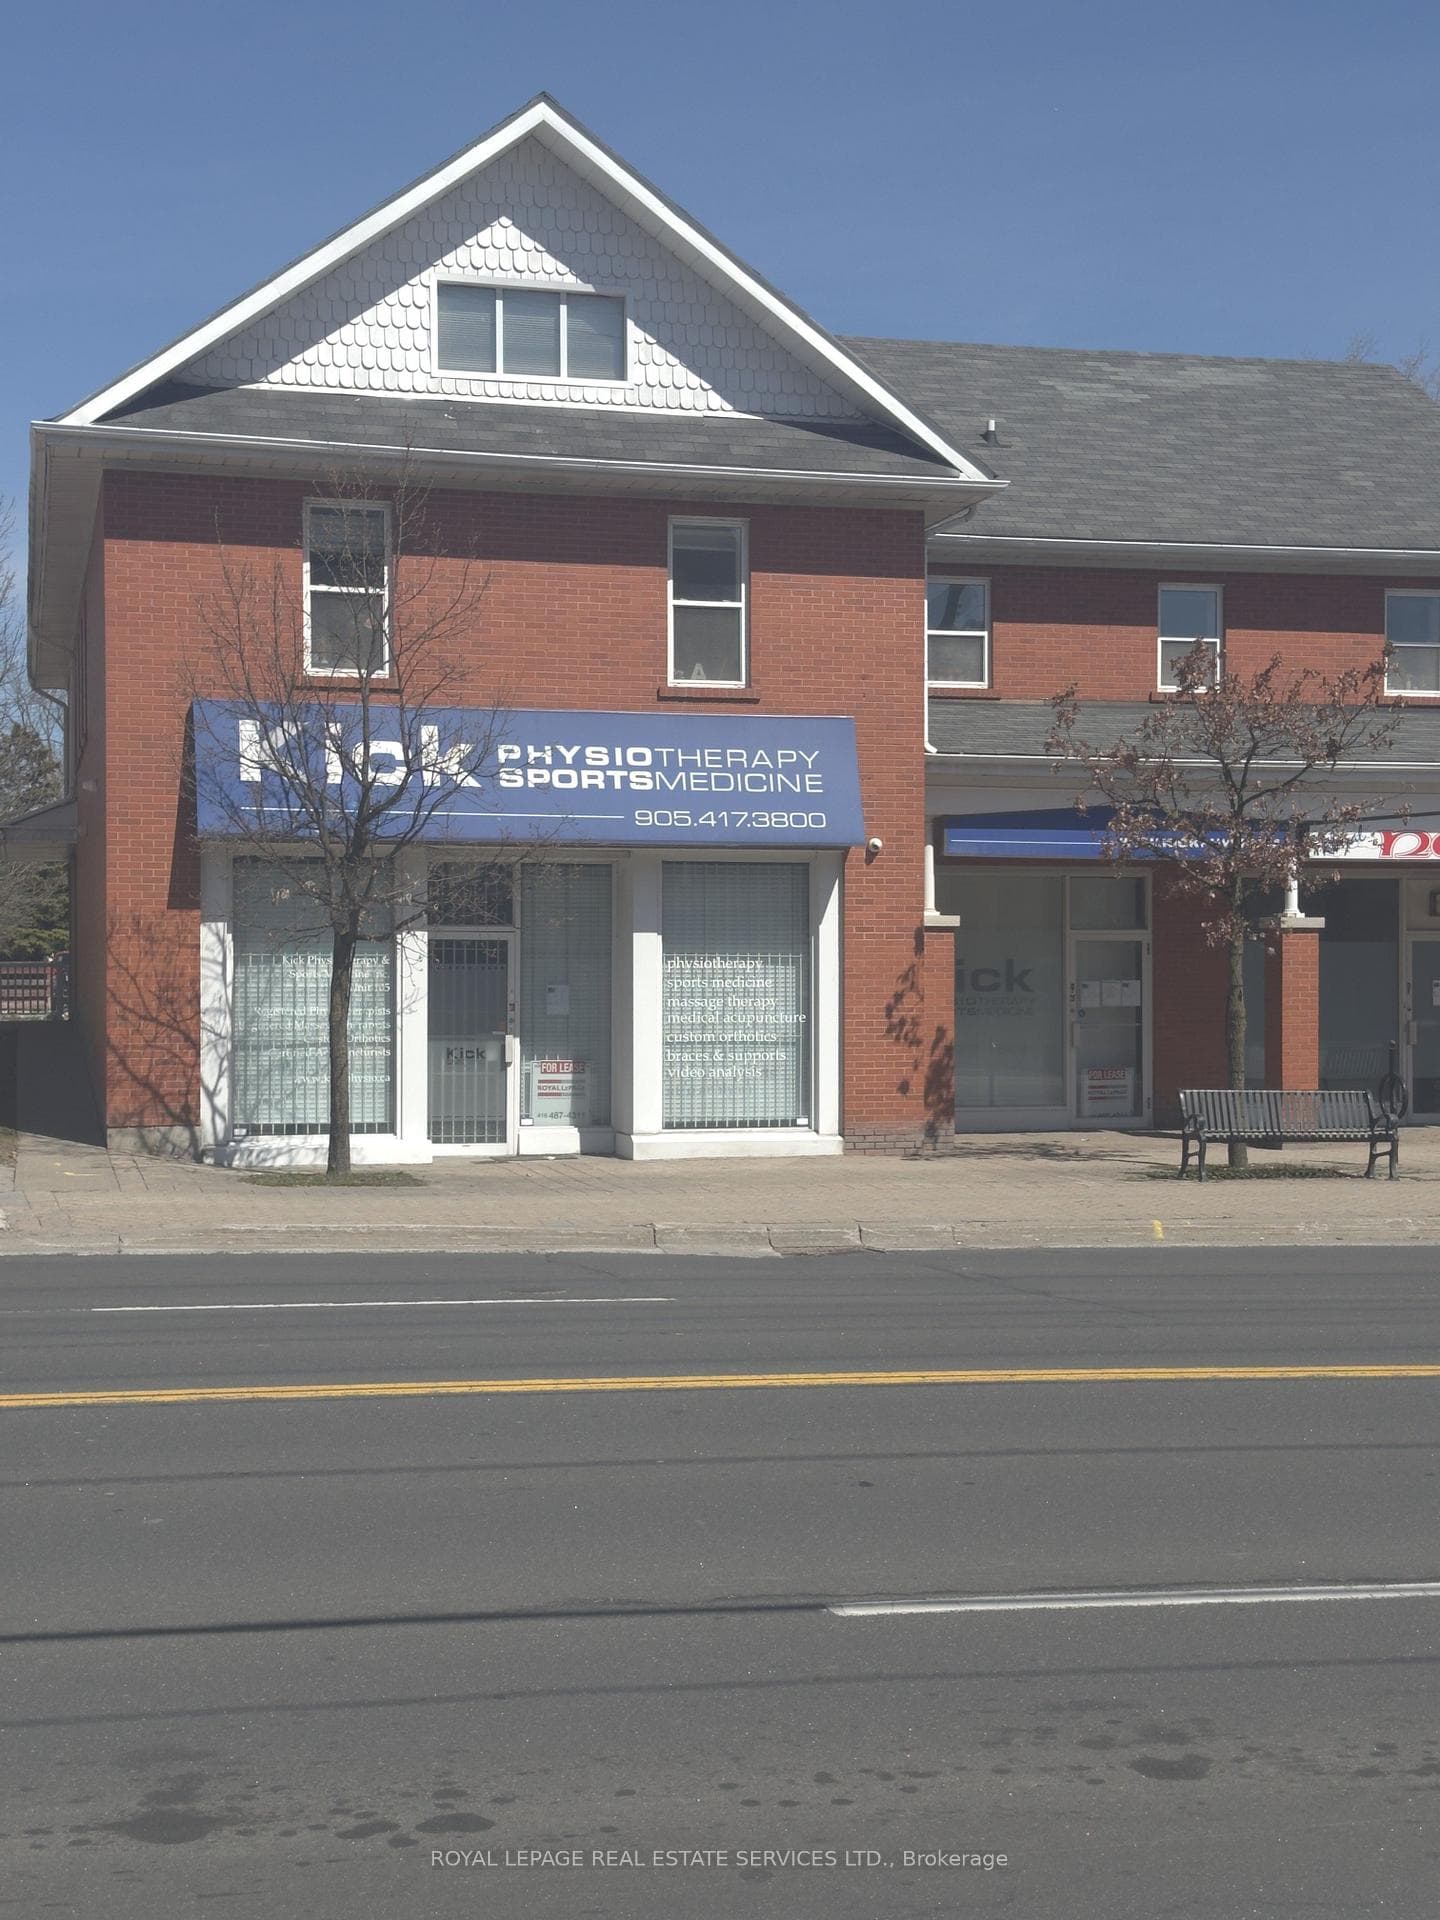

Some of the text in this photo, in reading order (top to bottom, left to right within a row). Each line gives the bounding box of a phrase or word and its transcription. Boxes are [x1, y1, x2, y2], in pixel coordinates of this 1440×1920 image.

[239, 719, 482, 787] Kick
[497, 744, 820, 769] PHYSIOTHERAPY
[499, 768, 824, 793] SPORTSMEDICINE
[634, 809, 828, 829] 905.417.3800
[283, 954, 391, 968] Kick Physrapy &
[666, 957, 763, 973] physiotherapy
[666, 975, 773, 992] sports medicine
[956, 959, 1034, 992] ick
[666, 995, 778, 1011] massage therapy
[666, 1011, 807, 1028] medical acupuncture
[666, 1030, 777, 1042] custom orthotics
[446, 1047, 487, 1059] Kick
[666, 1049, 787, 1065] braces & supports
[541, 1062, 585, 1073] FOR LEASE
[667, 1065, 762, 1082] video analysis
[1088, 1069, 1126, 1080] FOR LEASE
